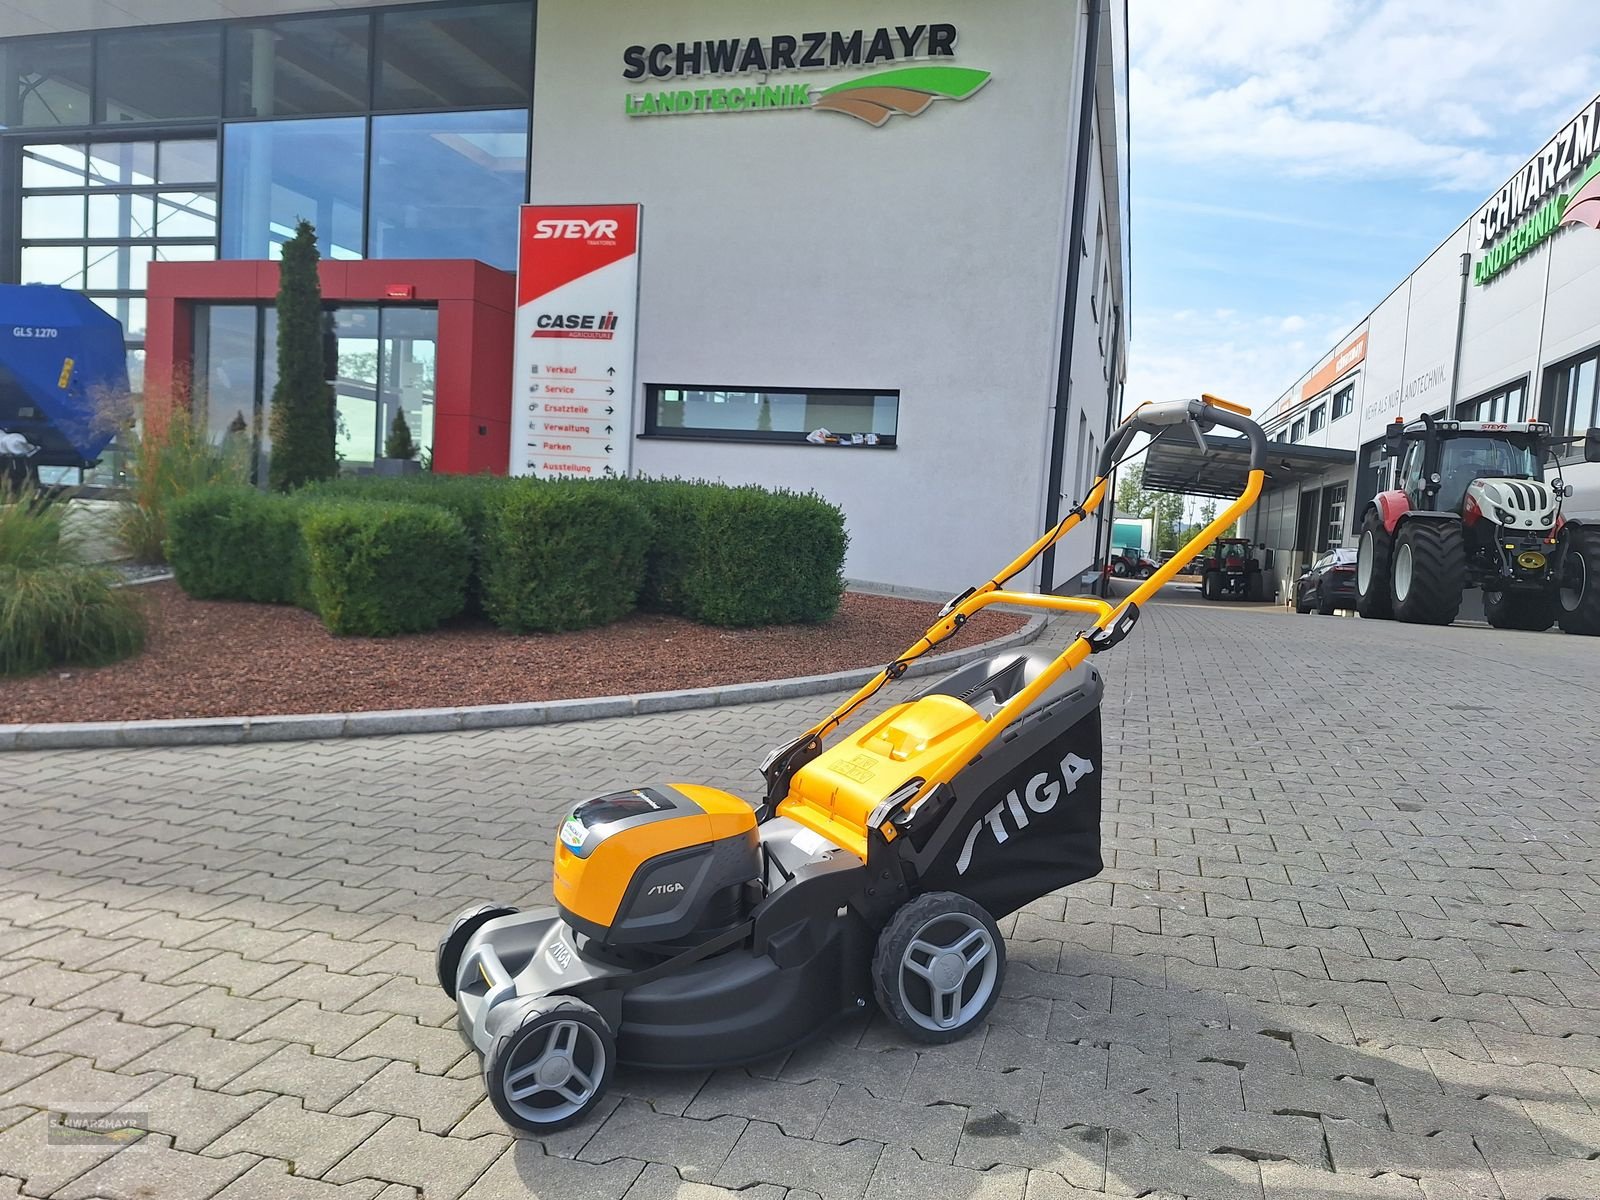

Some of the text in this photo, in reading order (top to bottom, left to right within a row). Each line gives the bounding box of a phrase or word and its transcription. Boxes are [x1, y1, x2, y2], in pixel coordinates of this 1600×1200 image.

[622, 23, 957, 79] SCHWARZMAYR
[625, 83, 811, 115] LANDTECHNIK
[532, 219, 619, 239] STEYR
[1473, 193, 1569, 286] LANDTECHNIK
[537, 314, 595, 329] CASE
[13, 327, 58, 338] GLS 1270
[545, 365, 577, 374] Verkauf
[544, 385, 575, 394] Service
[544, 404, 589, 413] Ersatzteile
[543, 423, 590, 433] Verwaltung
[543, 442, 572, 451] Parken
[542, 462, 591, 473] Ausstellung
[955, 752, 1095, 876] STIGA
[647, 882, 685, 895] STIGA
